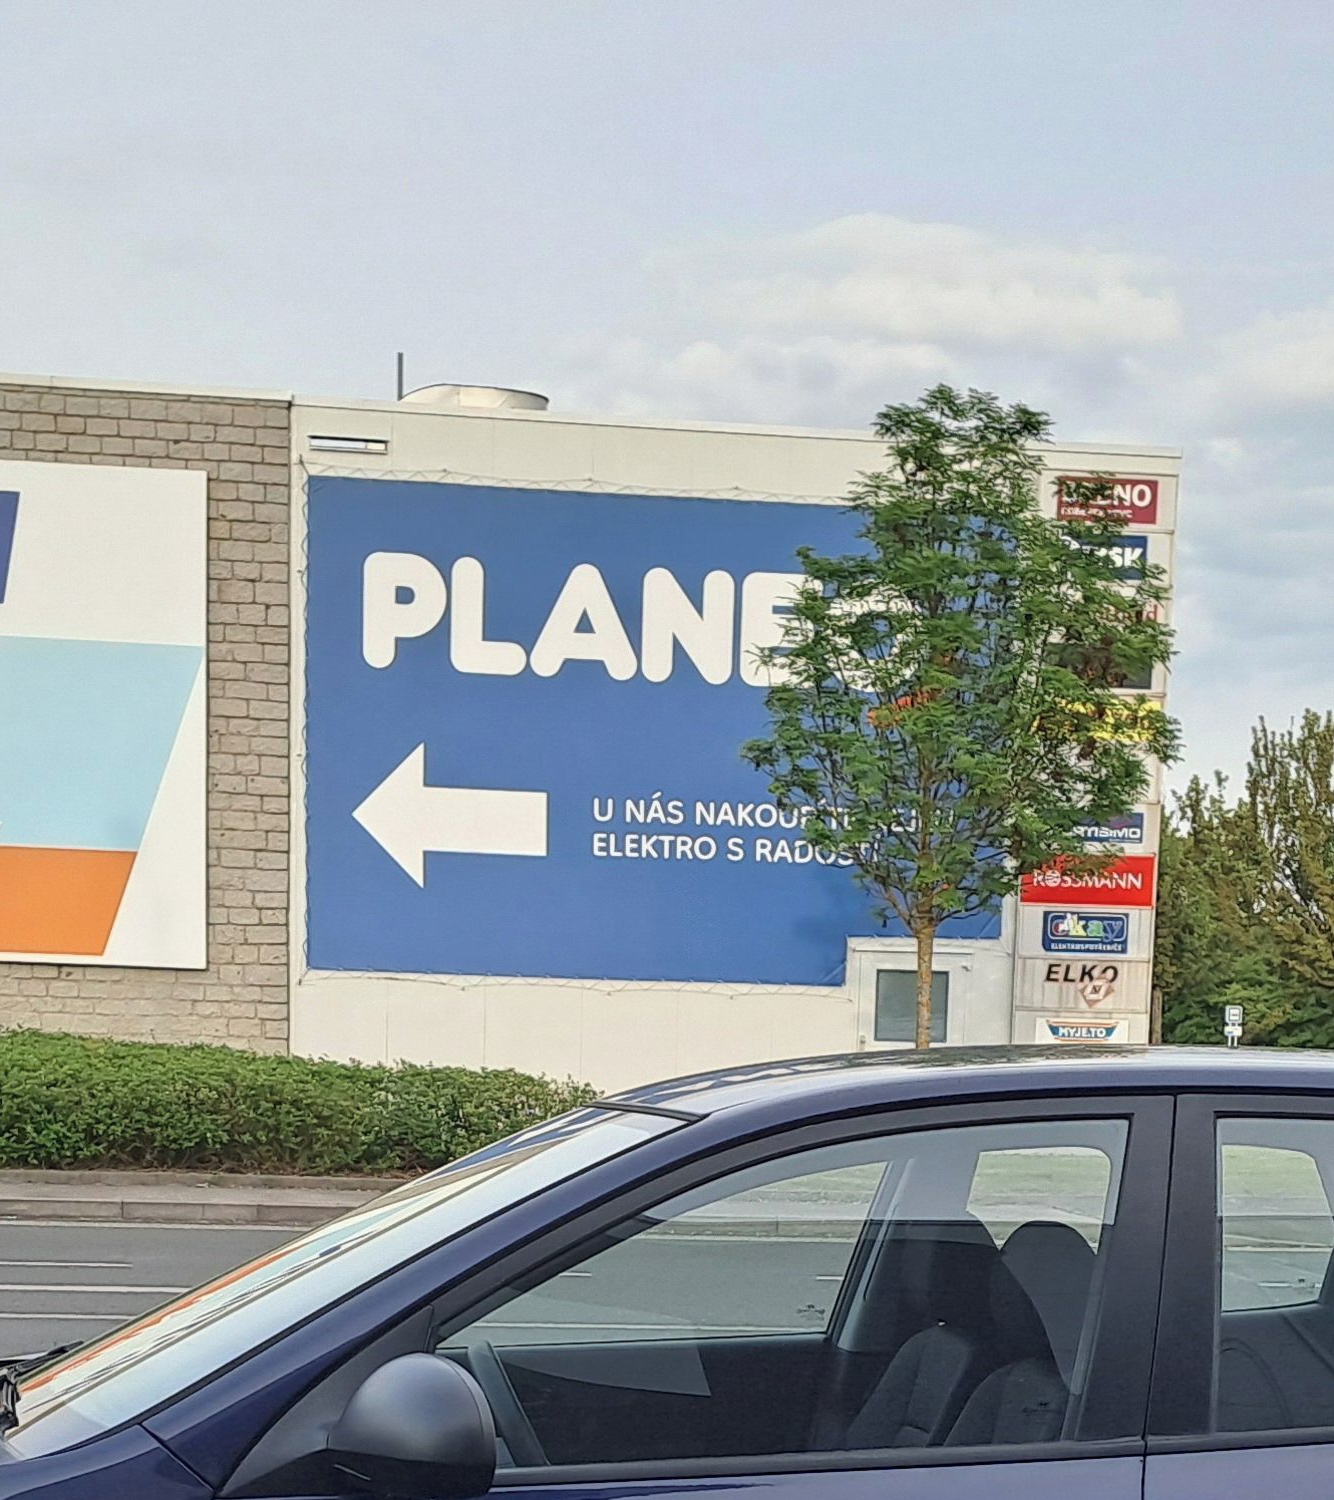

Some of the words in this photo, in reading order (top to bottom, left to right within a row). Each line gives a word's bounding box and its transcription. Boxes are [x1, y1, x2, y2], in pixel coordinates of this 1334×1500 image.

[593, 797, 614, 822] U
[625, 791, 684, 825] NÁS
[593, 833, 717, 860] ELEKTRO
[727, 837, 744, 861] S
[1045, 963, 1118, 984] ELKO
